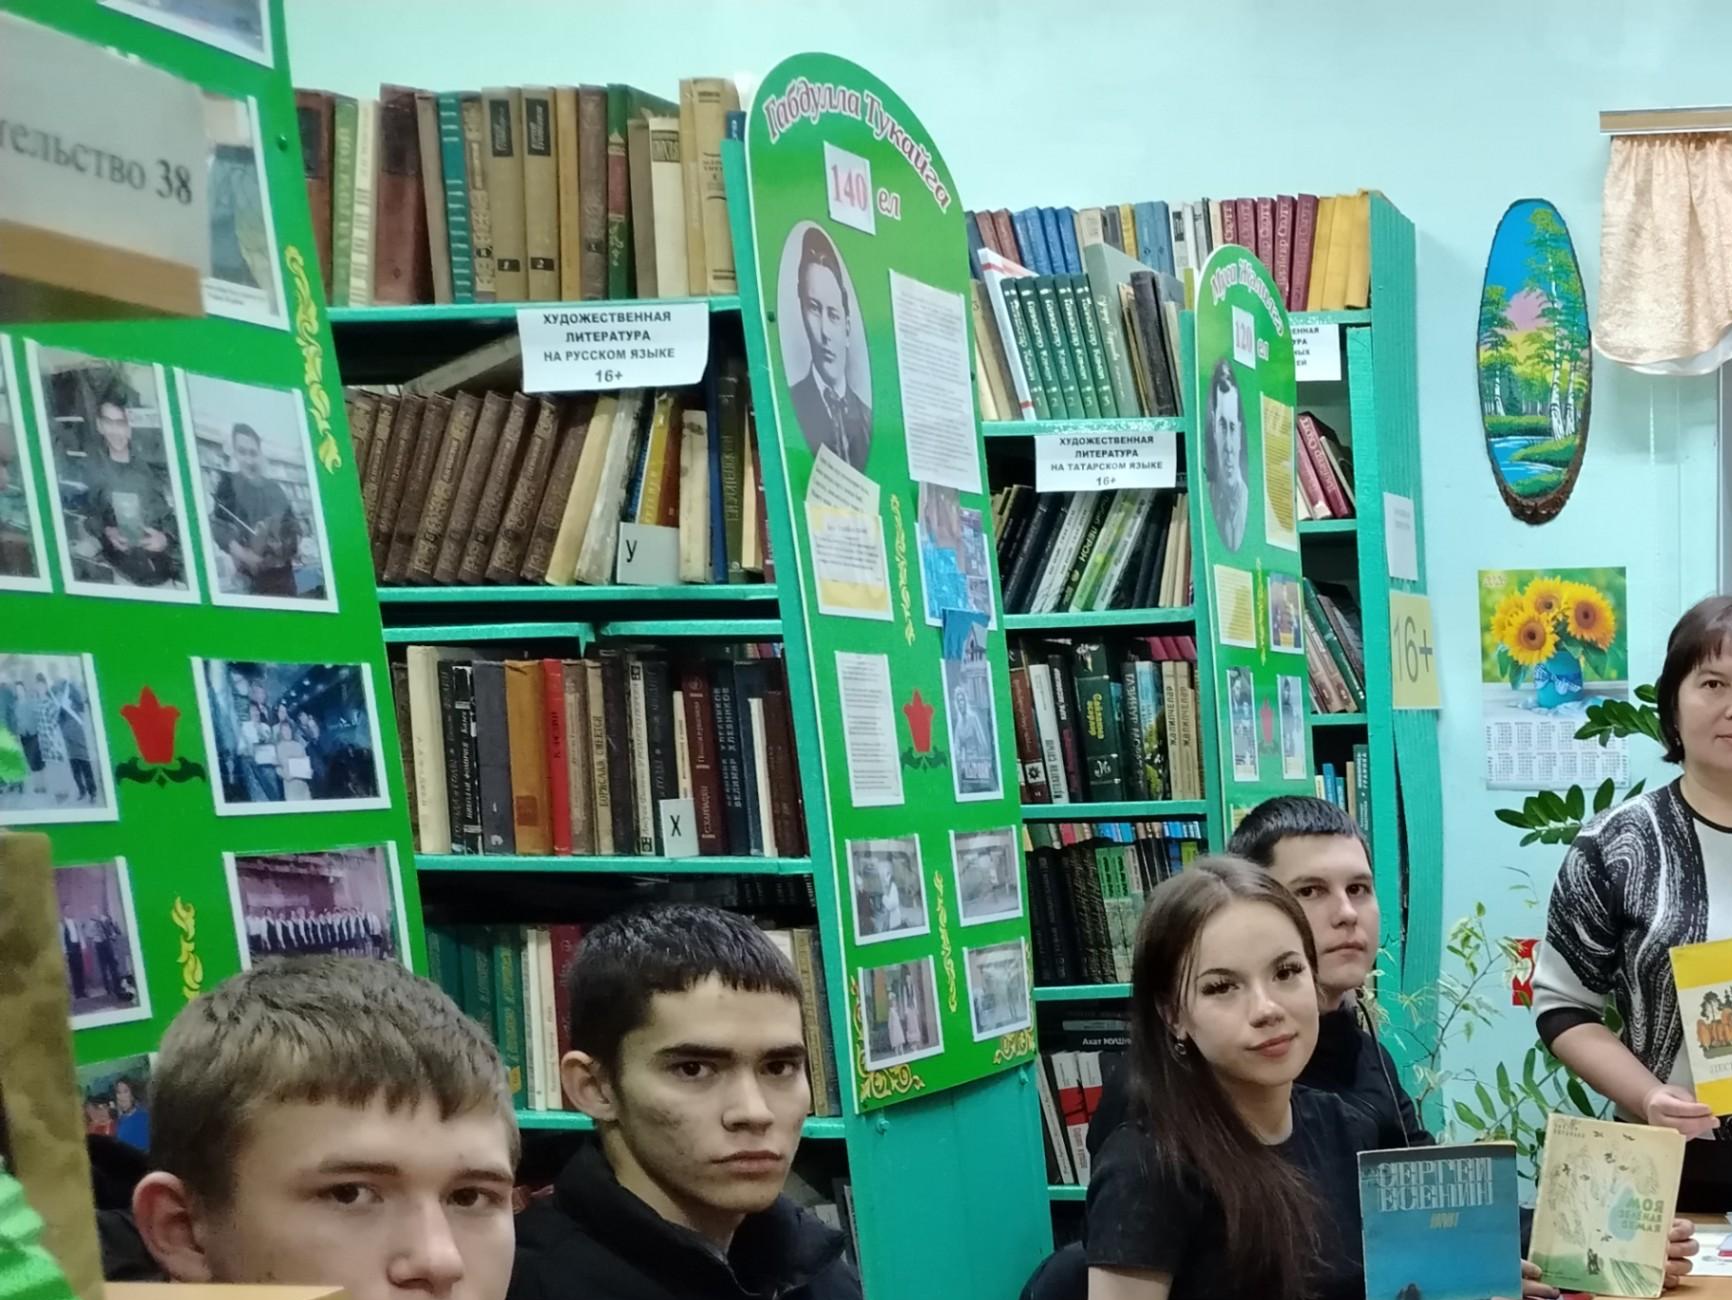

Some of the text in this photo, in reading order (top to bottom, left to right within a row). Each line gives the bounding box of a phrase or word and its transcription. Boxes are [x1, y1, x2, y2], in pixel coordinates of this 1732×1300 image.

[763, 77, 951, 214] Габдулла Тукайга
[155, 158, 194, 206] 38
[831, 164, 901, 220] 140 ел
[543, 311, 672, 325] ХУДОЖЕСТВЕННАЯ
[566, 330, 651, 343] ЛИТЕРАТУРА
[1292, 327, 1320, 335] ЕННАЯ
[543, 348, 676, 362] НА РУССКОМ ЯЗЫКЕ
[595, 369, 624, 383] 16+
[1059, 436, 1154, 447] ХУДОЖЕСТВЕННАЯ
[1075, 449, 1139, 459] ЛИТЕРАТУРА
[1051, 461, 1164, 472] НА ТАТАРСКОМ ЯЗЫКЕ
[1392, 615, 1433, 684] 16+
[723, 687, 737, 751] ХЛЕБНИКОВ
[669, 814, 682, 837] Х
[1380, 1182, 1493, 1212] ЕСЕНИН
[1625, 1198, 1664, 1214] МОЯ
